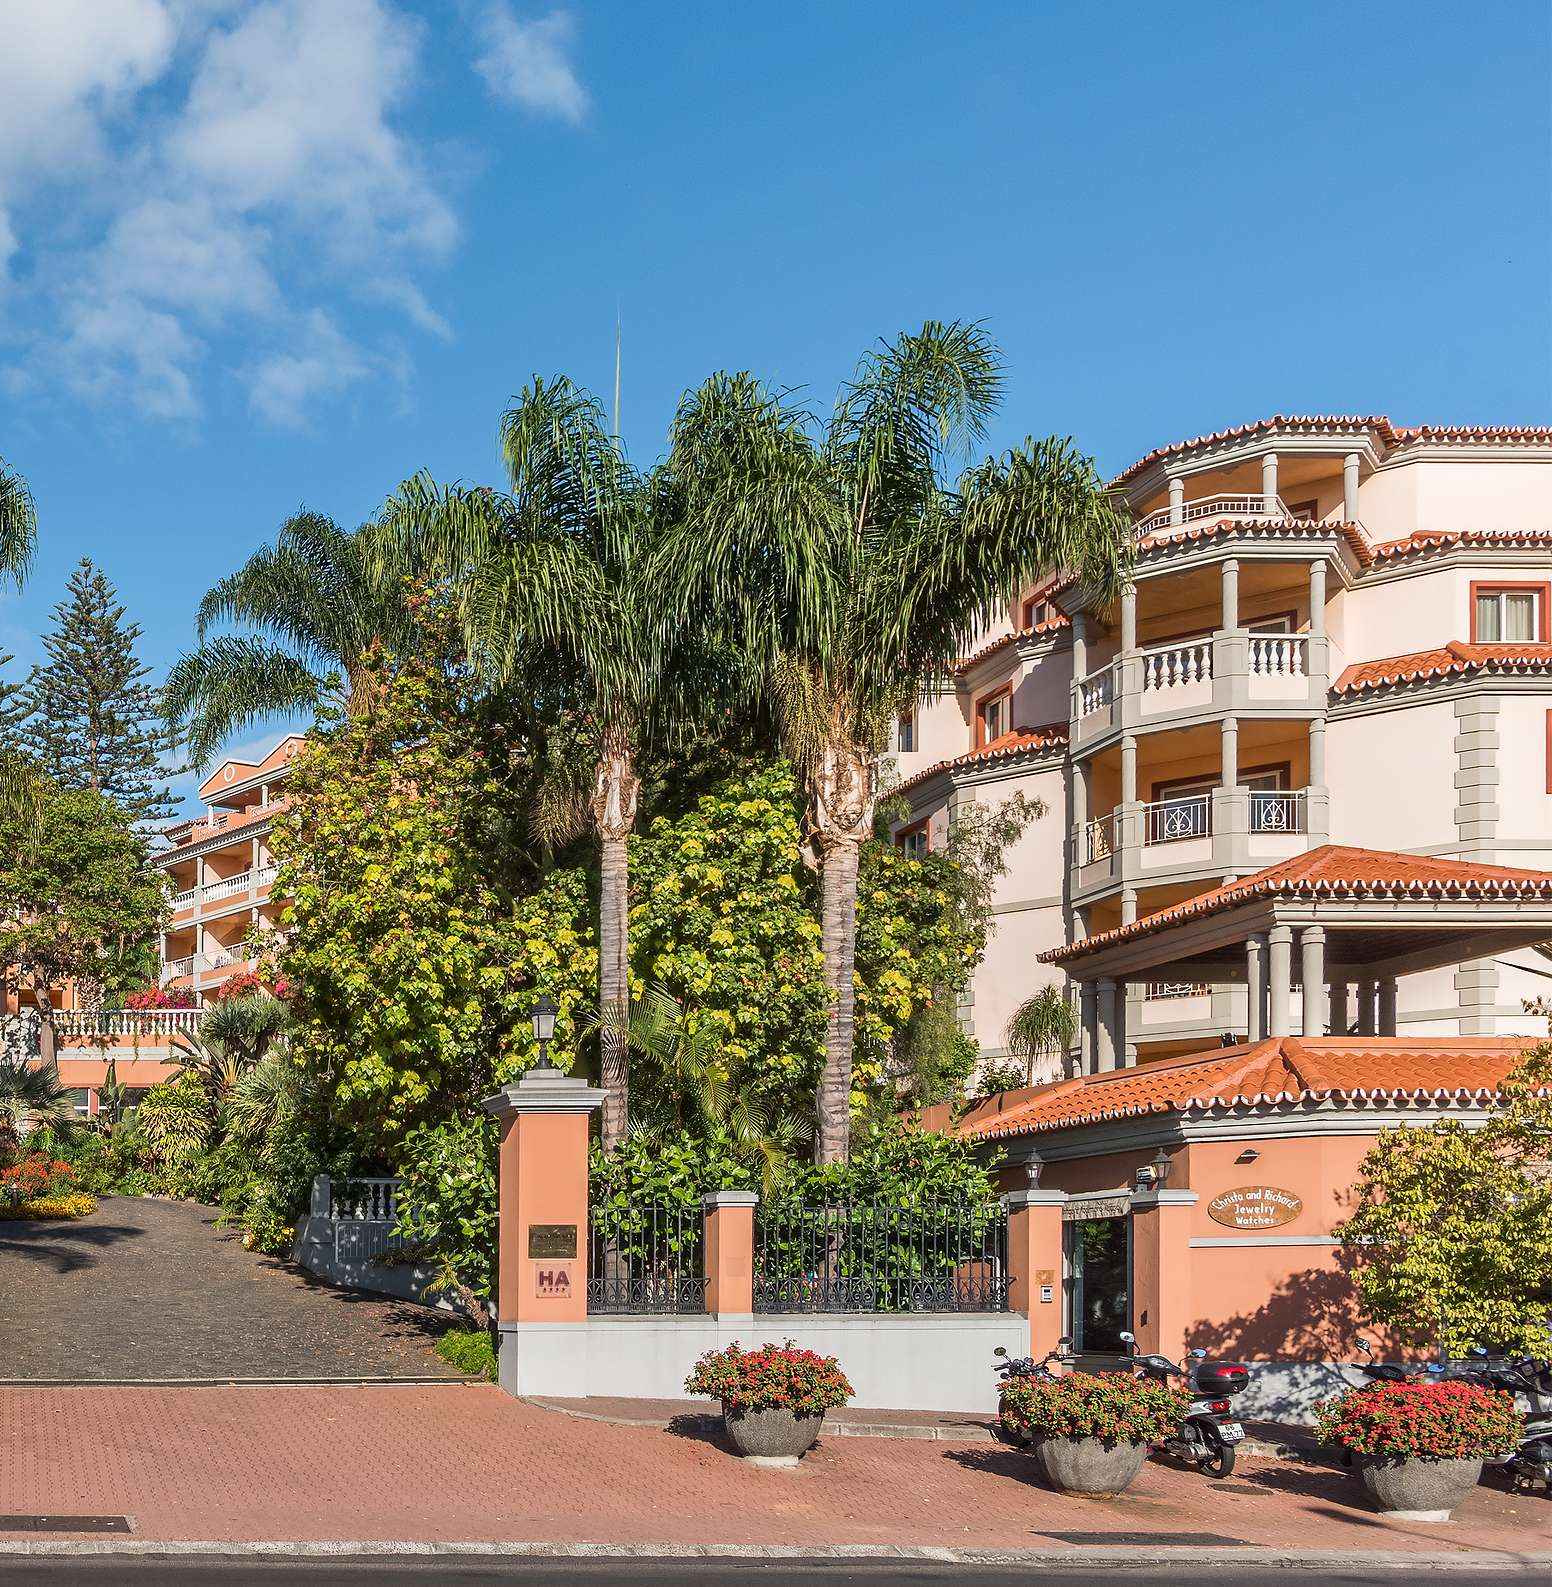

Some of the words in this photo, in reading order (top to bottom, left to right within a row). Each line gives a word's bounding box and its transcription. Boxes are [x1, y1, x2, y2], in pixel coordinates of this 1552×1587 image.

[1211, 1191, 1243, 1210] Christa
[1245, 1188, 1262, 1200] and
[1264, 1189, 1300, 1209] Richard
[1234, 1202, 1275, 1215] Jewelry
[1235, 1216, 1275, 1225] Watches
[539, 1270, 570, 1287] HA
